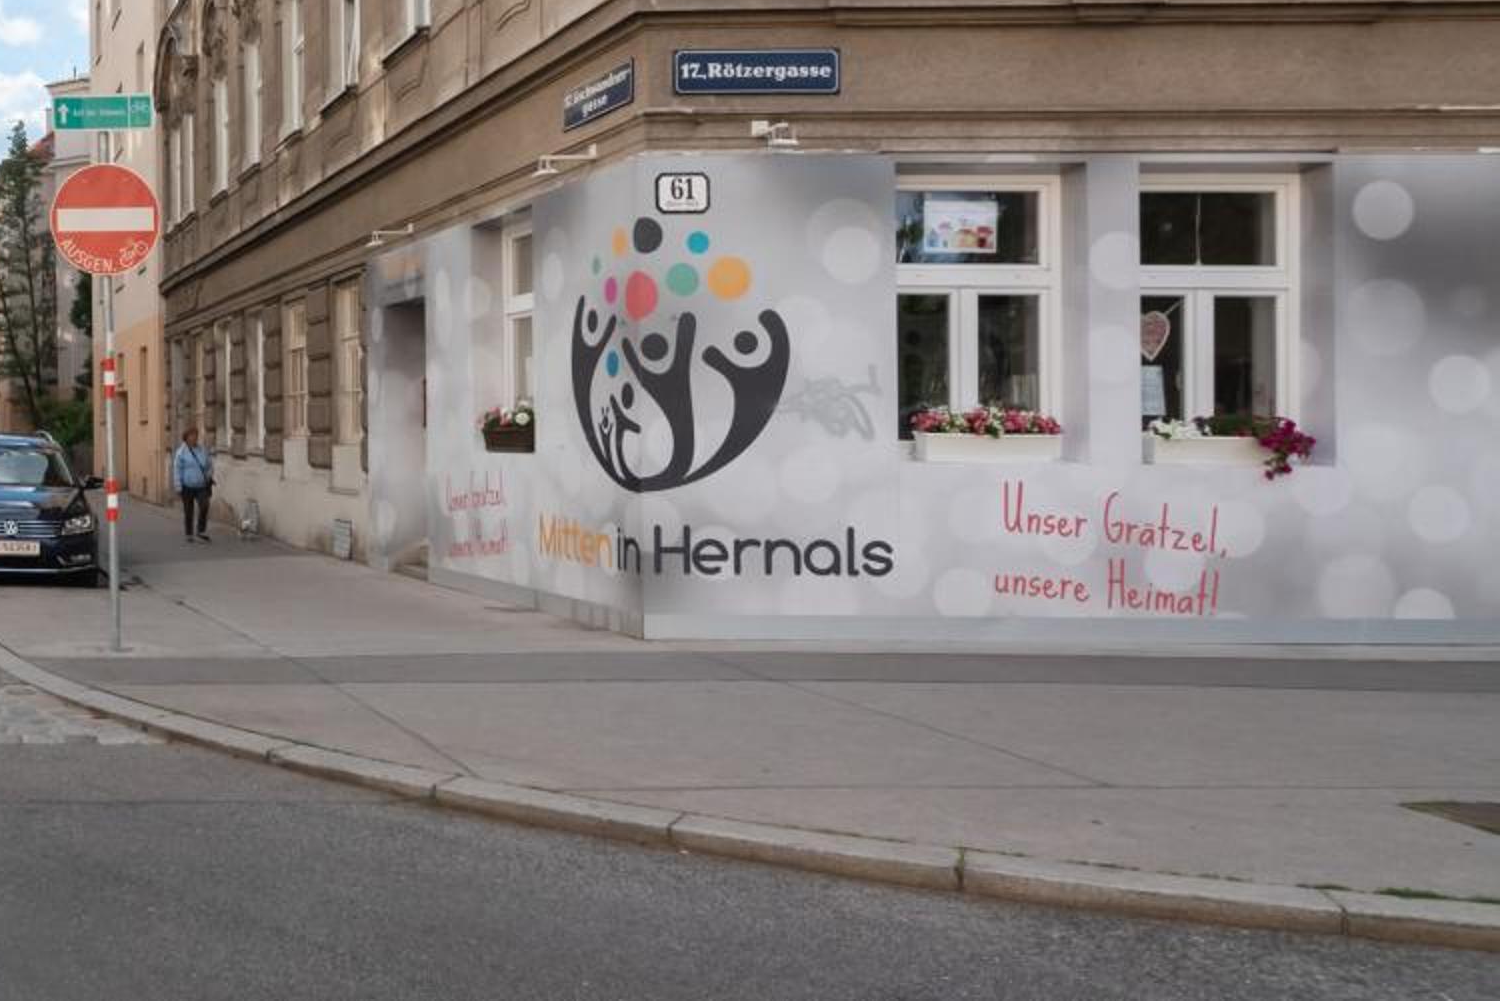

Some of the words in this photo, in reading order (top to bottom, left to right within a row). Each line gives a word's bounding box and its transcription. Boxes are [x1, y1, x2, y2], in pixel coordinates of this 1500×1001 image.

[671, 178, 695, 200] 61
[60, 239, 118, 272] AUSGEN.
[538, 511, 613, 569] Mitten
[615, 526, 641, 574] in
[653, 524, 895, 577] Hernals
[1003, 480, 1089, 539] Unser
[1103, 491, 1228, 559] Grätzel,
[995, 572, 1091, 603] unsere
[1106, 558, 1220, 616] Heimat!
